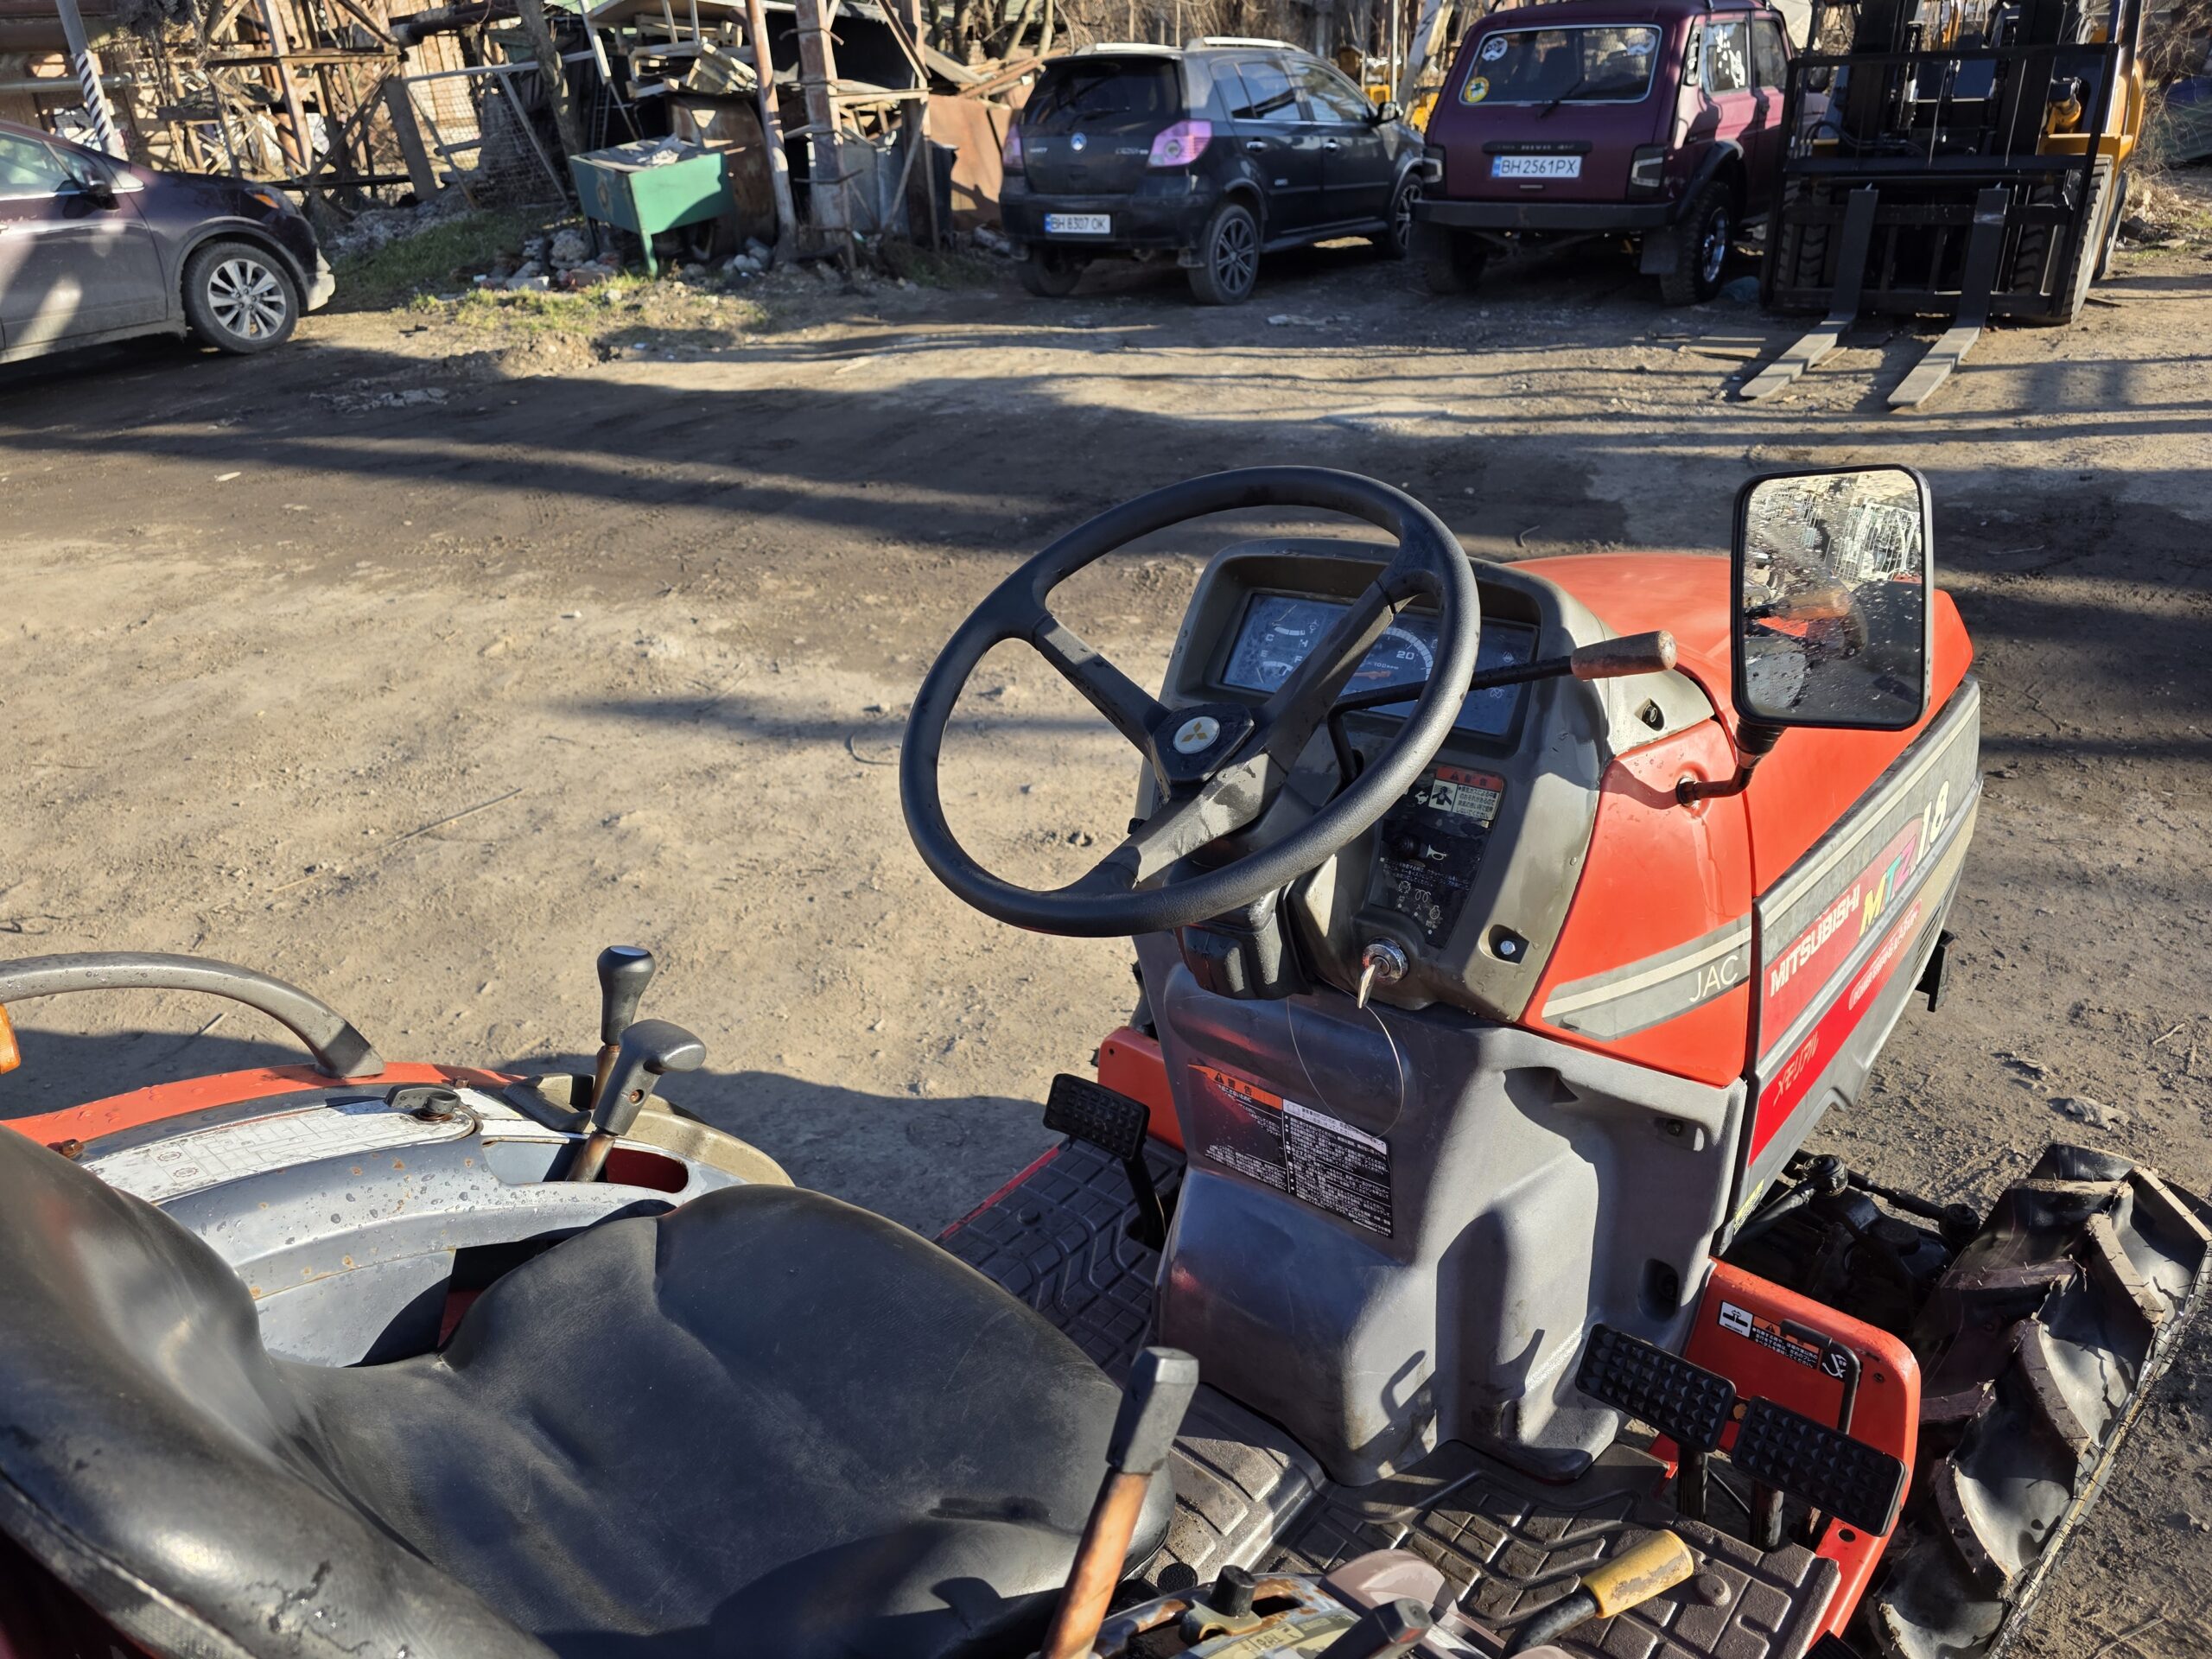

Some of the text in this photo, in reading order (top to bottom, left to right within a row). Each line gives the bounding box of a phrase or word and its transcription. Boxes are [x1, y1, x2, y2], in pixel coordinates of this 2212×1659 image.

[1264, 633, 1275, 642] C
[1298, 639, 1309, 648] H
[1260, 649, 1269, 658] E
[1395, 650, 1415, 660] 20
[1294, 655, 1303, 664] F
[1770, 884, 1860, 997] MITSUBISHI
[1689, 955, 1738, 1002] JAC
